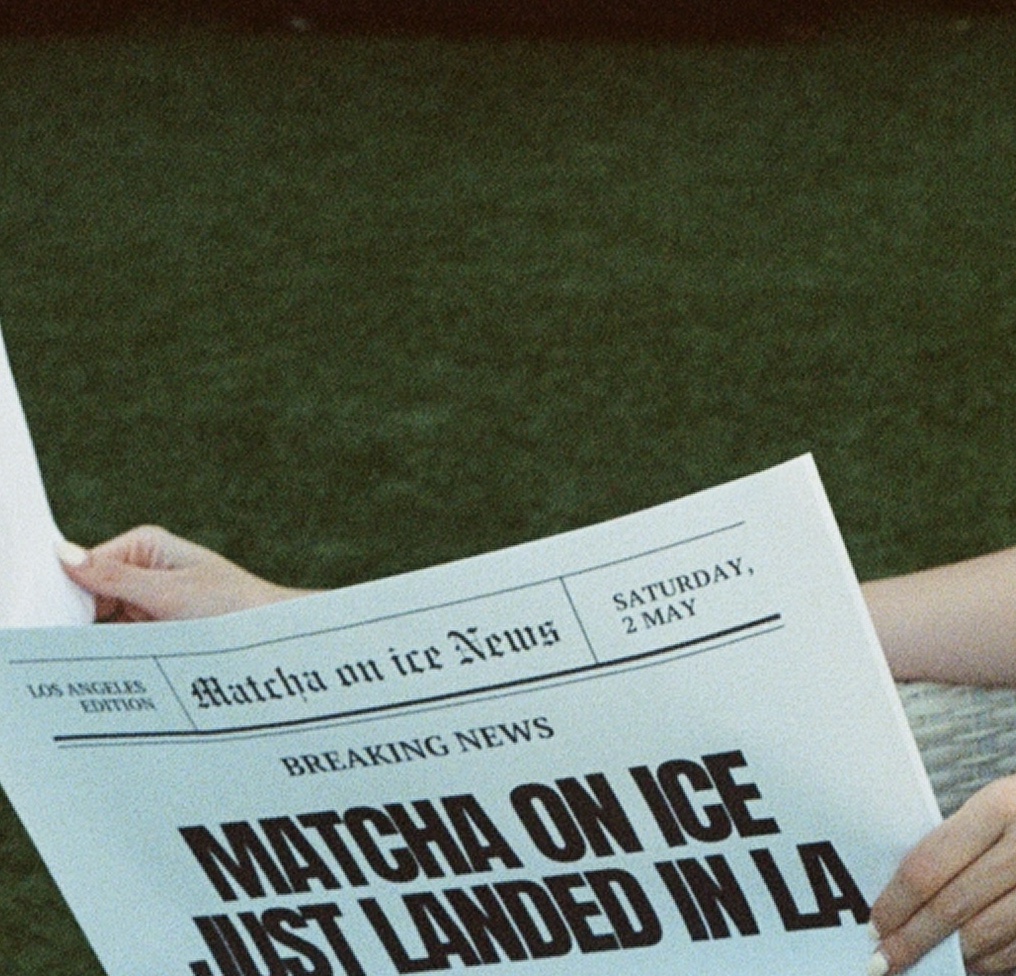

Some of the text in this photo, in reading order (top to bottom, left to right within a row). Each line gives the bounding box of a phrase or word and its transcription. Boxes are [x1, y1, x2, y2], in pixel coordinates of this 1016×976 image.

[612, 557, 754, 611] SATURDAY,
[621, 597, 697, 635] 2 MAY
[27, 680, 147, 699] LOS ANGELES
[190, 626, 562, 709] Matcha on ice News
[79, 697, 156, 714] EDITION
[280, 716, 555, 778] BREAKING NEWS
[177, 749, 782, 902] MATCHA ON ICE
[356, 867, 664, 976] LANDED
[654, 853, 761, 942] IN
[749, 840, 872, 932] LA
